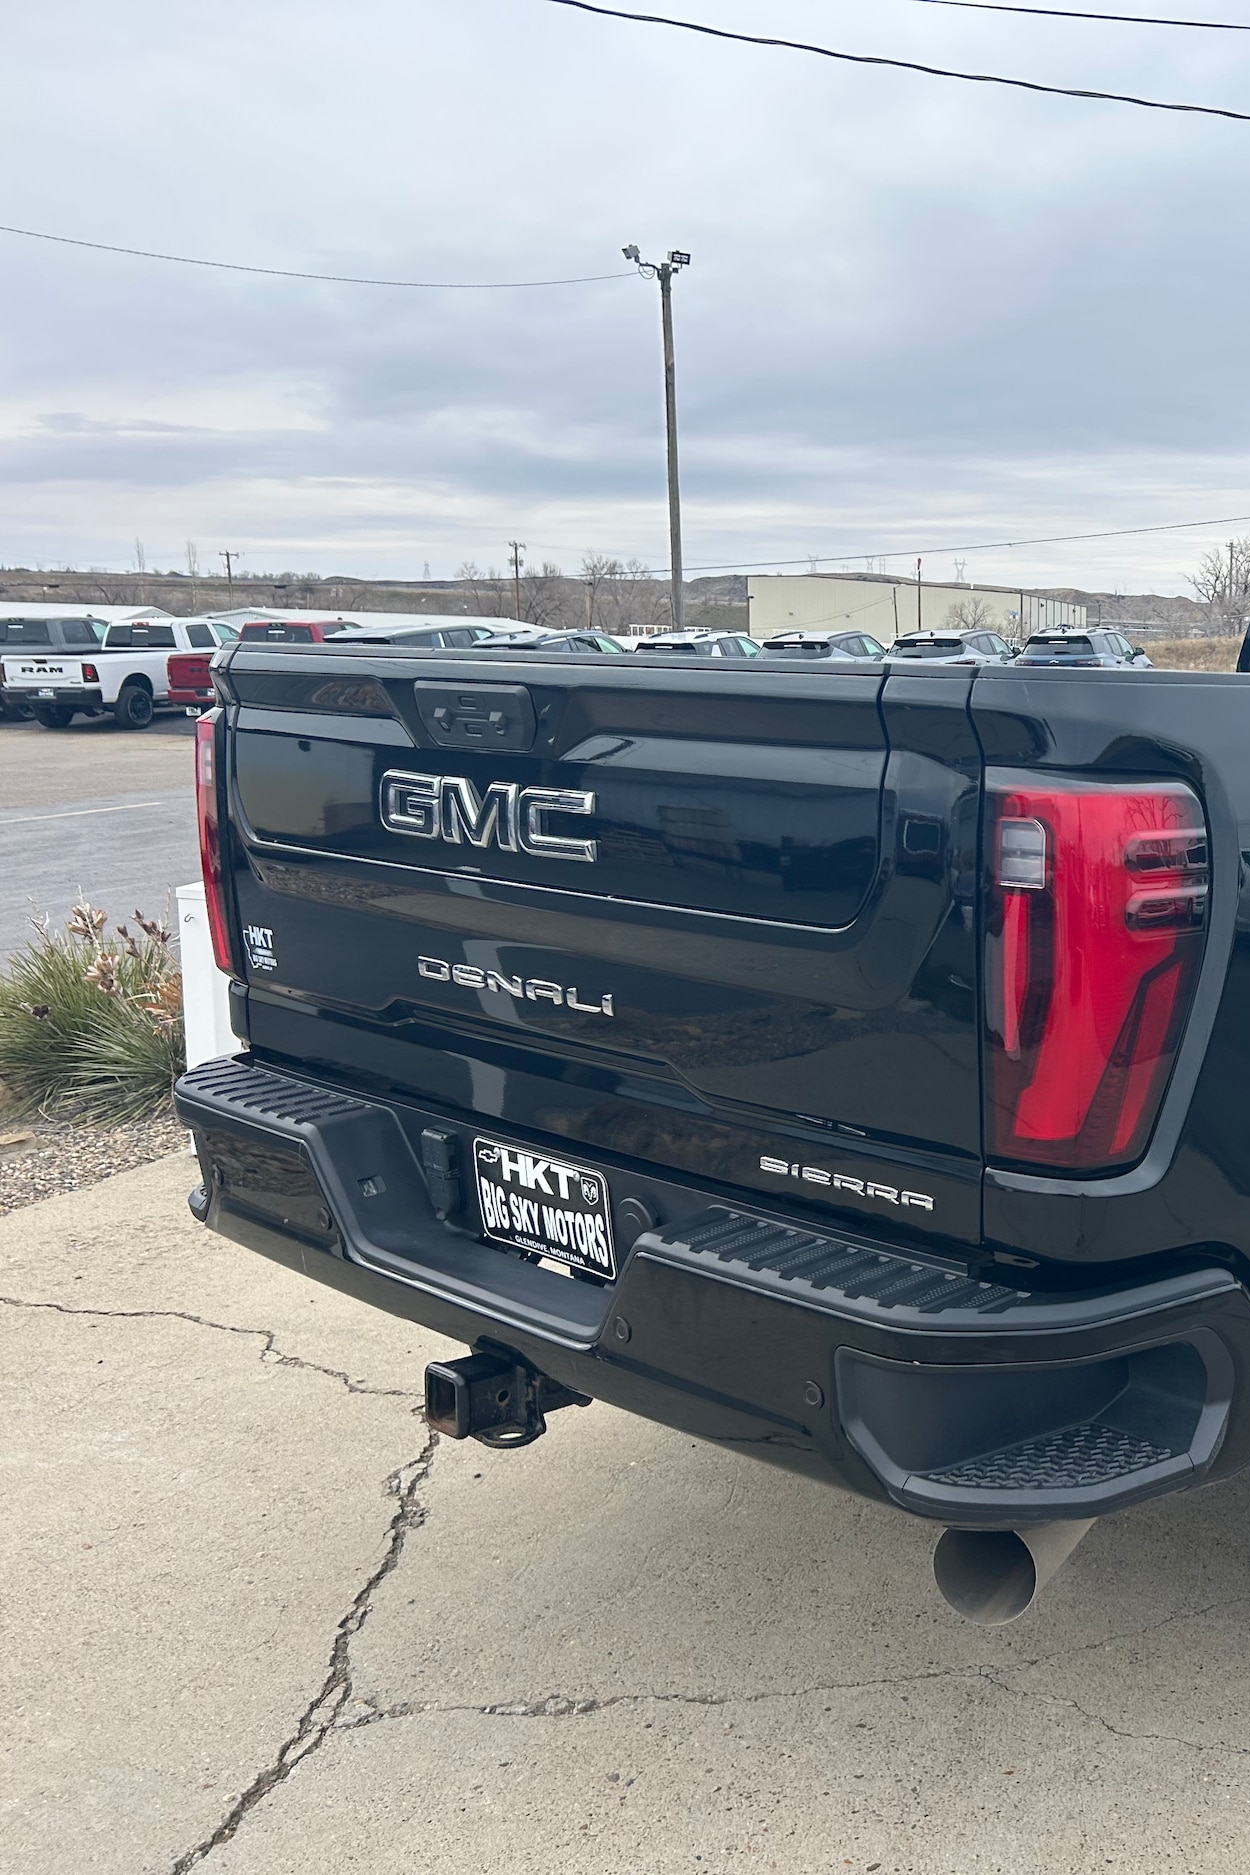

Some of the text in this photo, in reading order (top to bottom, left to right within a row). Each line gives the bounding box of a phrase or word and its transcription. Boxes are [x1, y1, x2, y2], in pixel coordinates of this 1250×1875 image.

[379, 768, 598, 863] GMC
[247, 924, 273, 949] HKT
[417, 955, 615, 1018] DENALI
[499, 1149, 574, 1200] HKT
[759, 1155, 936, 1212] SIERRA
[480, 1176, 609, 1268] BIG SKY MOTORS
